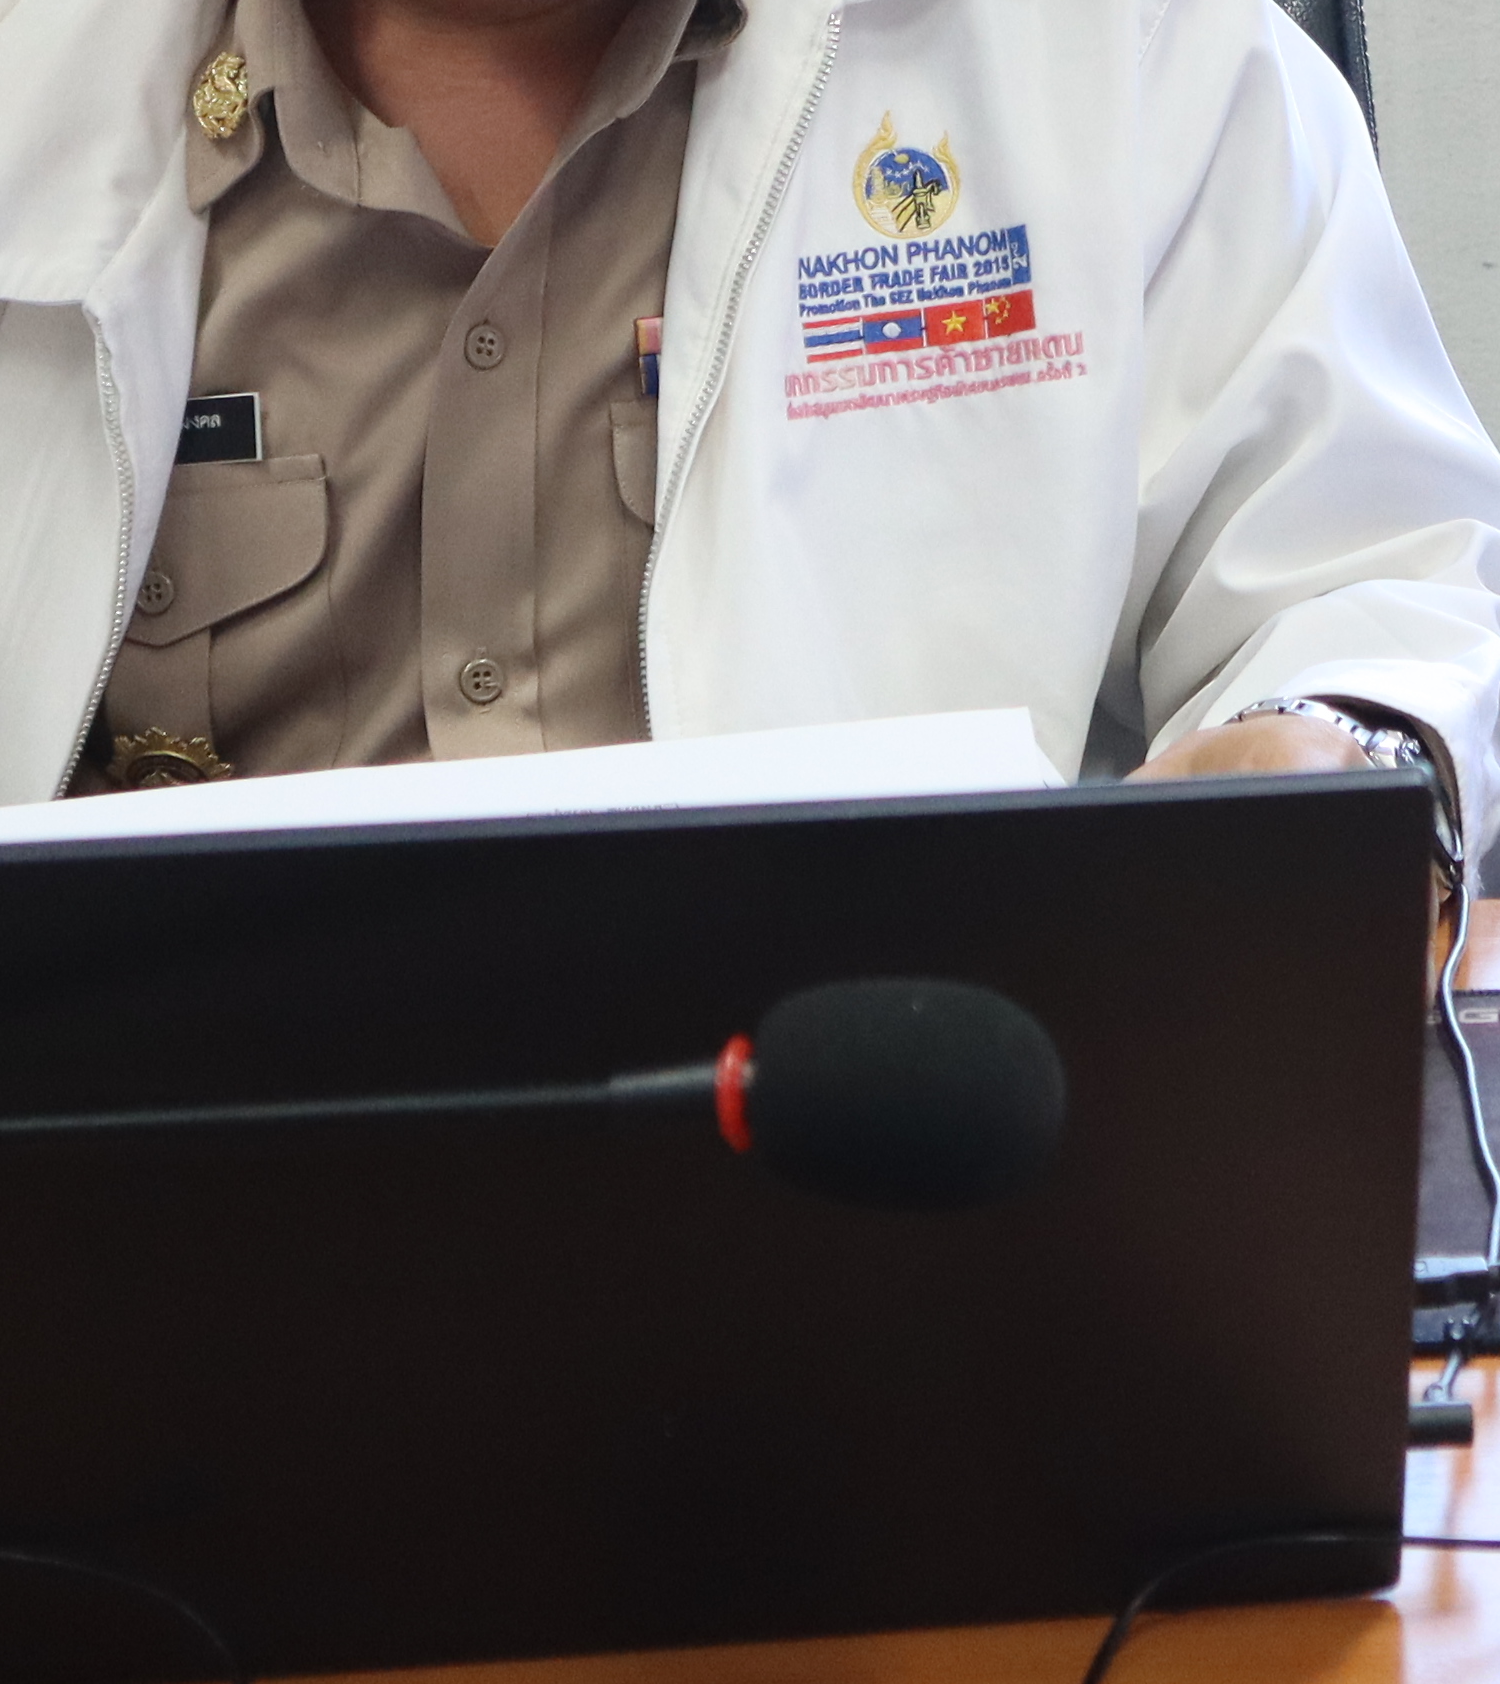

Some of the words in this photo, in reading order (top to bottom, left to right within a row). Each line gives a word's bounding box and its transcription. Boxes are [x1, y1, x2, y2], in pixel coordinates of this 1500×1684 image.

[799, 243, 899, 280] NAKHON
[906, 229, 1008, 266] PHANOM
[799, 276, 864, 301] BORDER
[869, 268, 926, 291] TRADE
[930, 261, 969, 283] FAIR
[799, 297, 861, 318] Promotion
[864, 292, 886, 309] The
